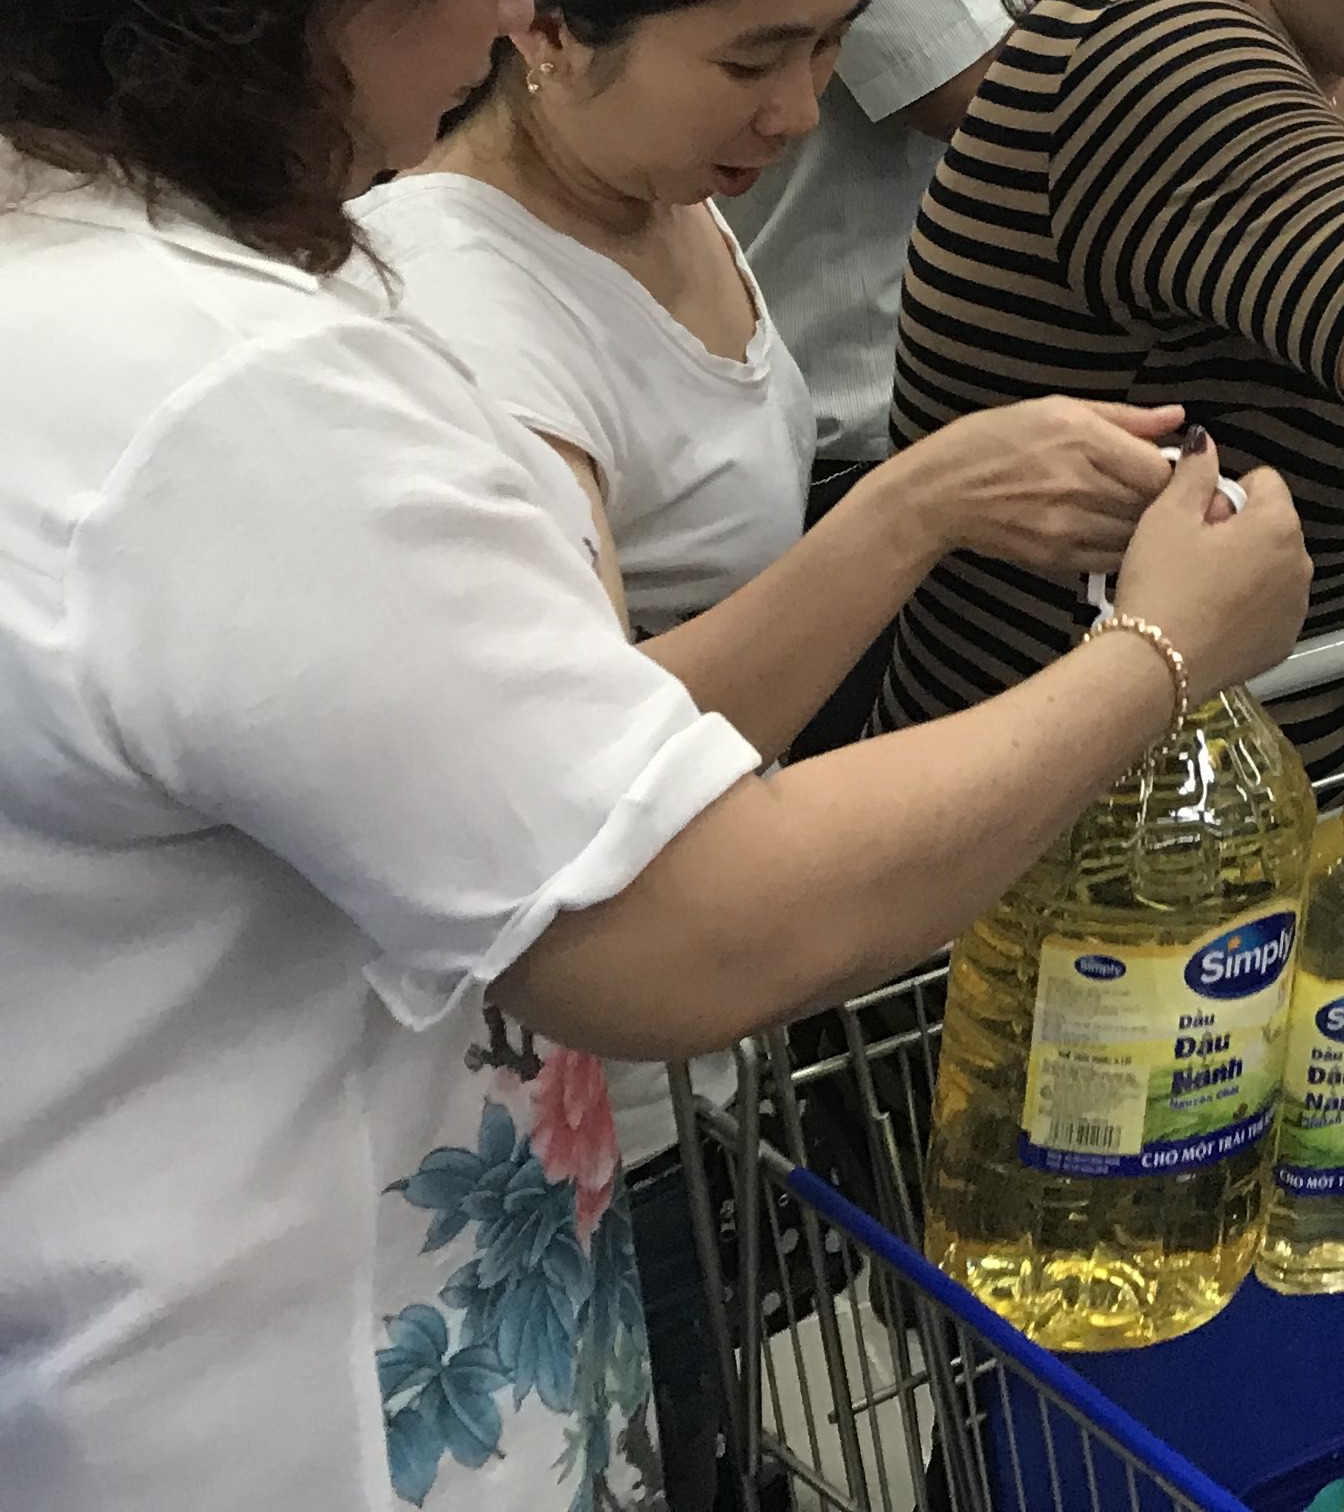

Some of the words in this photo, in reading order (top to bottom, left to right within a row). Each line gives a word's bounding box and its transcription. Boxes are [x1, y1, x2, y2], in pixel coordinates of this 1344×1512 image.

[1201, 929, 1293, 985] Simply
[1175, 1033, 1230, 1061] Đậu
[1142, 1149, 1178, 1169] CHO
[1279, 1169, 1304, 1189] CHO
